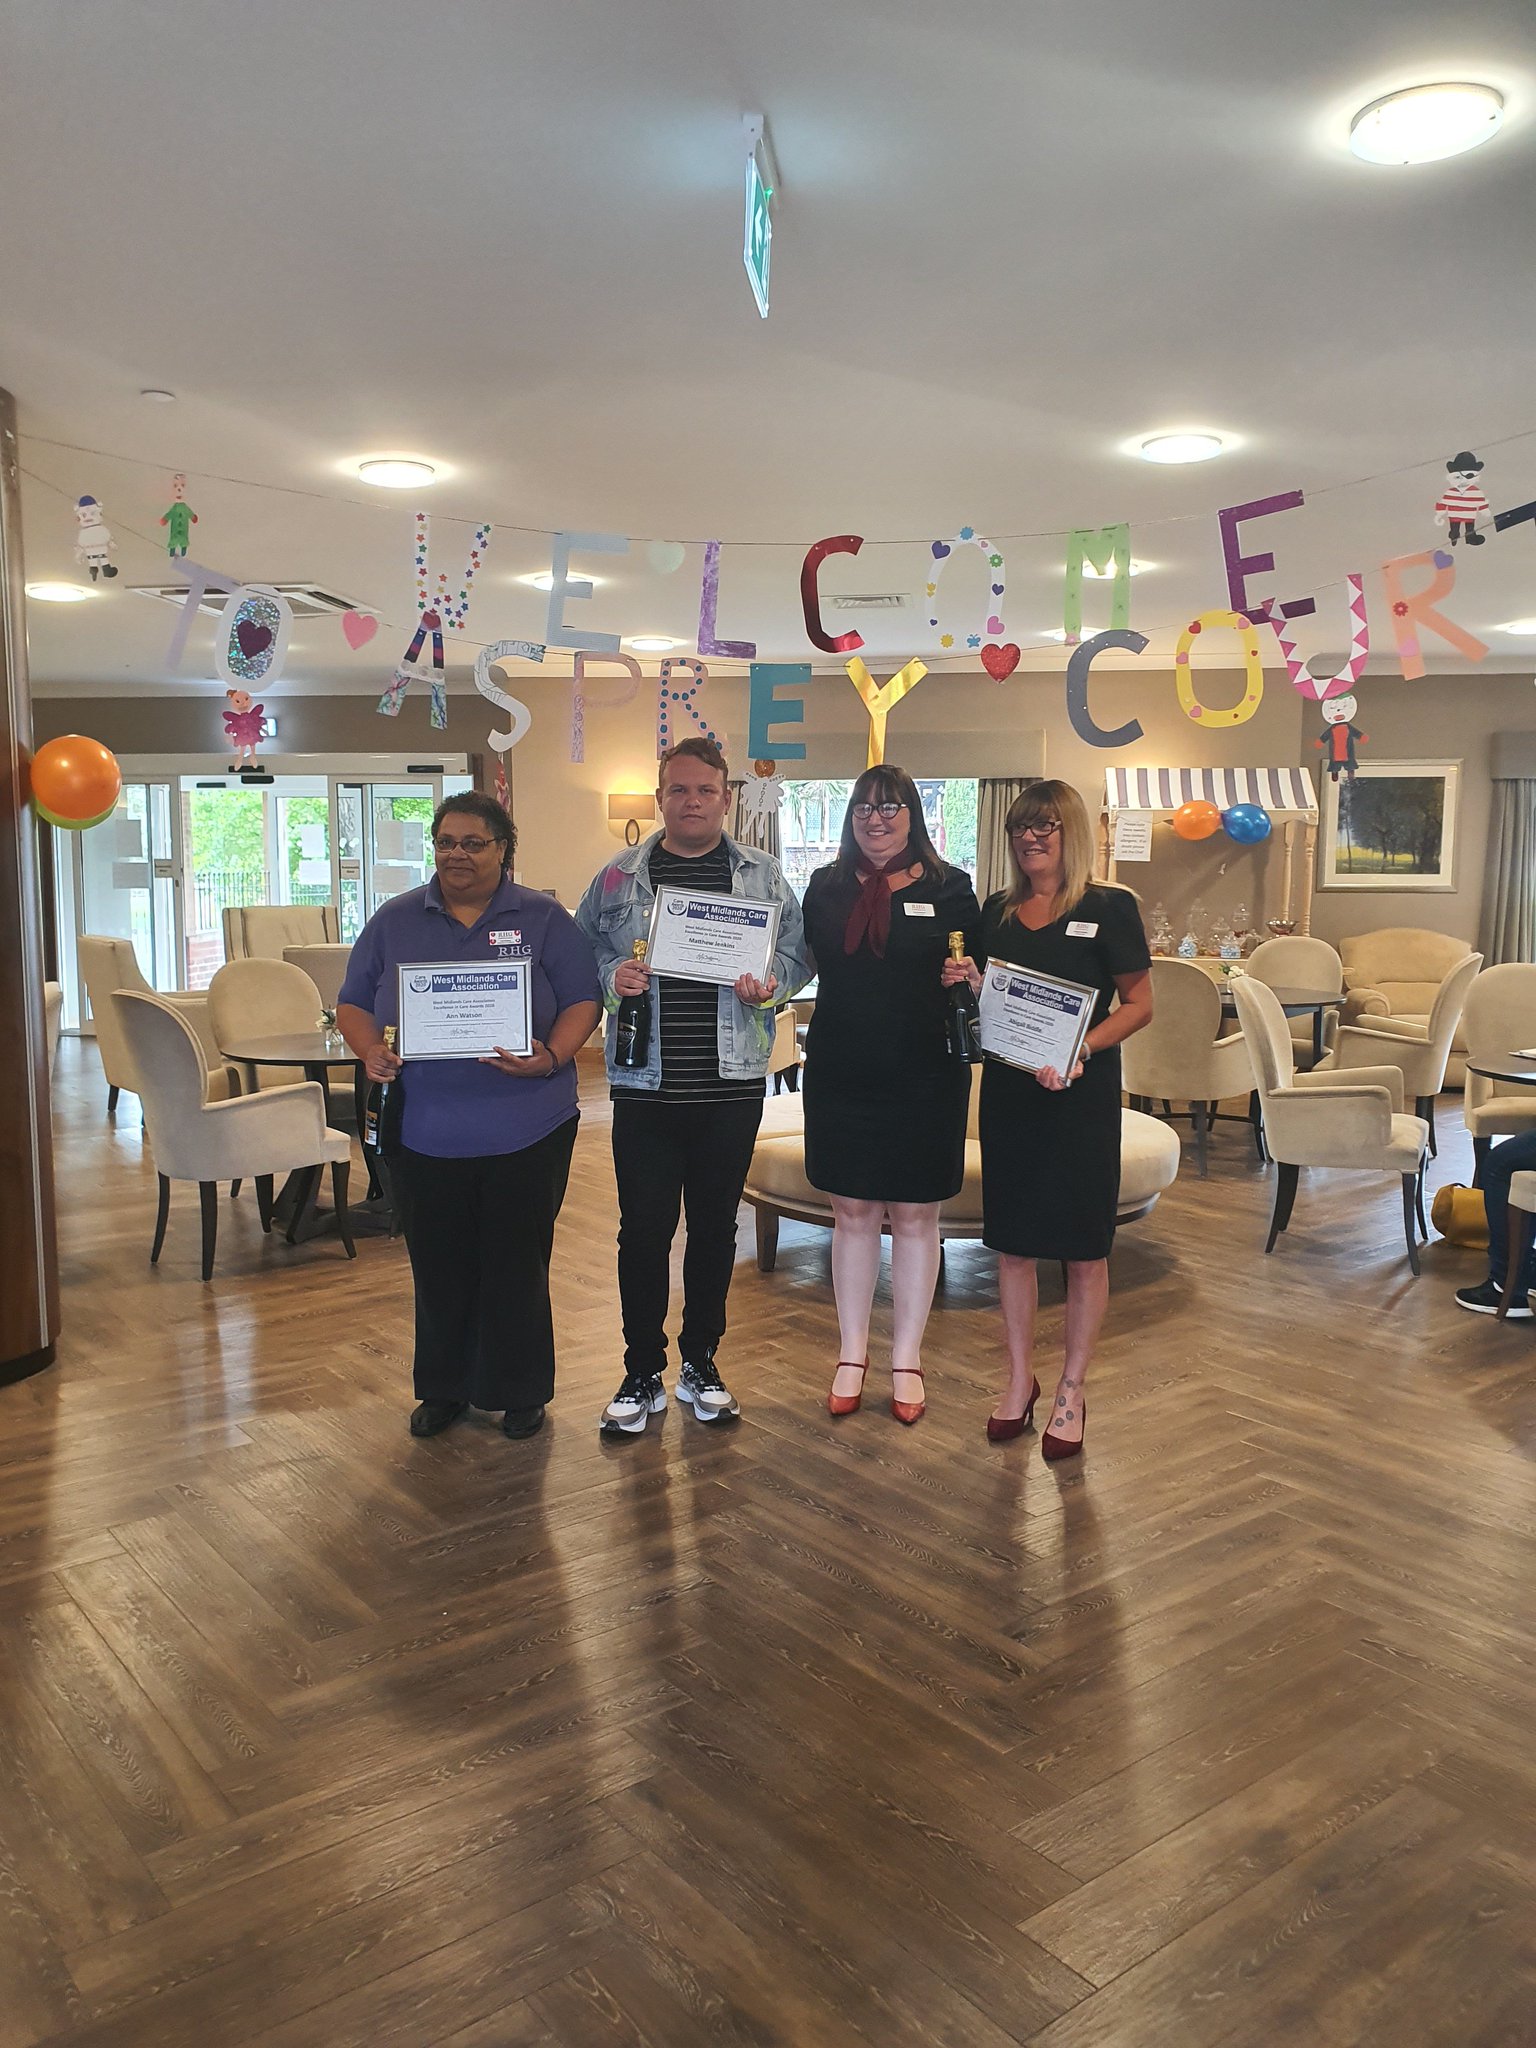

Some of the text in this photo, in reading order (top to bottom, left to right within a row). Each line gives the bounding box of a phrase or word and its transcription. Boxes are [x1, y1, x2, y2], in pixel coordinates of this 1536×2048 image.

[414, 489, 1317, 660] WELCOME
[376, 612, 930, 769] ASPREY
[1066, 500, 1536, 749] COUR
[689, 902, 709, 912] West
[711, 905, 746, 917] Midlands
[748, 911, 767, 920] Care
[704, 913, 750, 925] Association
[689, 937, 735, 949] Matthew Jenkins
[498, 945, 532, 957] RHG
[433, 975, 455, 984] West
[459, 973, 495, 983] Midlands
[497, 973, 517, 982] Care
[451, 982, 500, 991] Association
[1010, 978, 1029, 990] West
[1029, 985, 1062, 1001] Midlands
[1063, 995, 1080, 1008] Care
[1022, 991, 1064, 1010] Association
